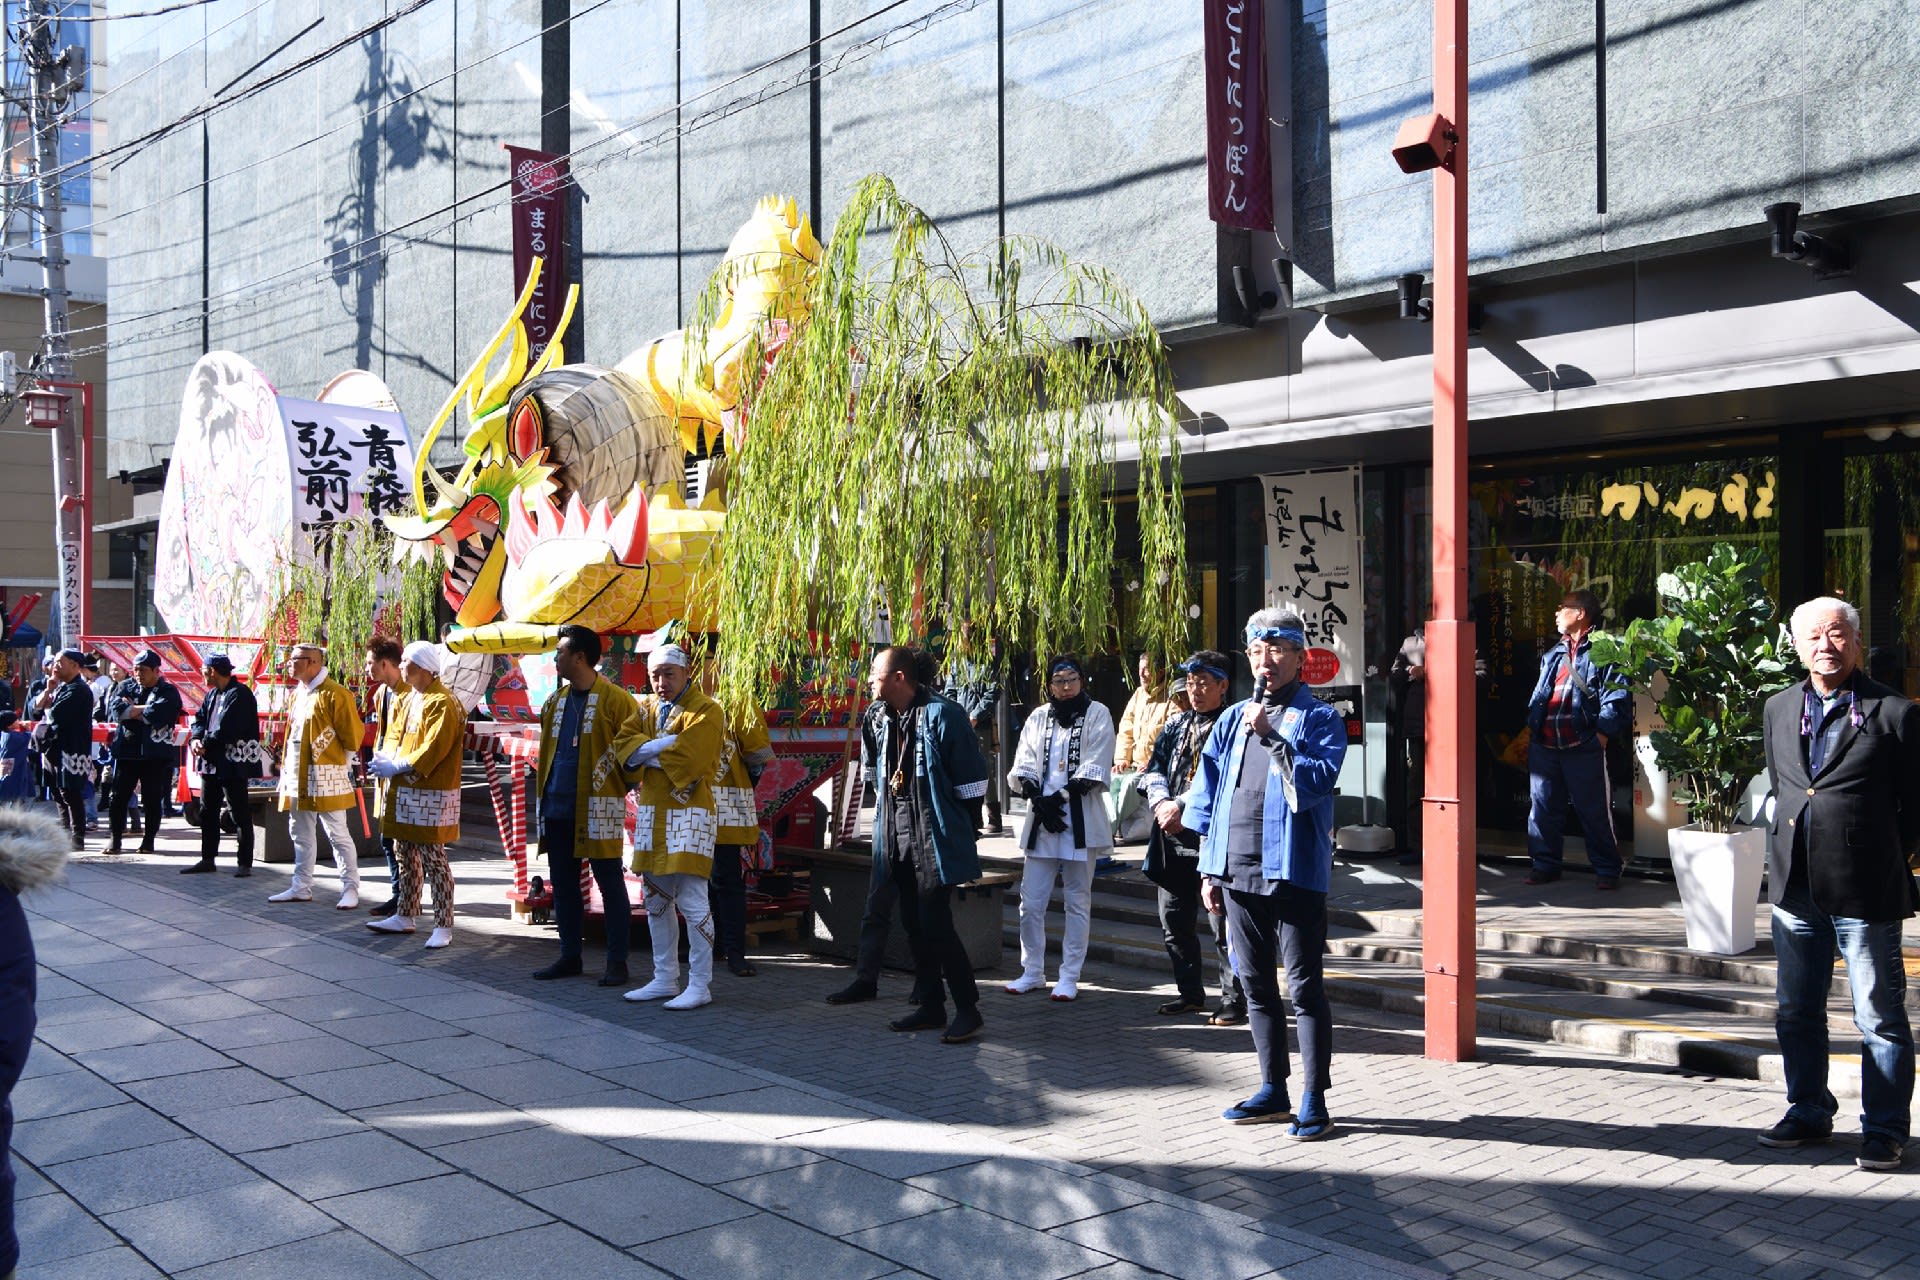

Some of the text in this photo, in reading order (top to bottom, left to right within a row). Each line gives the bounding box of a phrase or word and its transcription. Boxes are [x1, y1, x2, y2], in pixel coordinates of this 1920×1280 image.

[1225, 1, 1248, 212] ごとにっぽん
[1601, 472, 1776, 525] かねすえ
[65, 563, 80, 613] タカハシ
